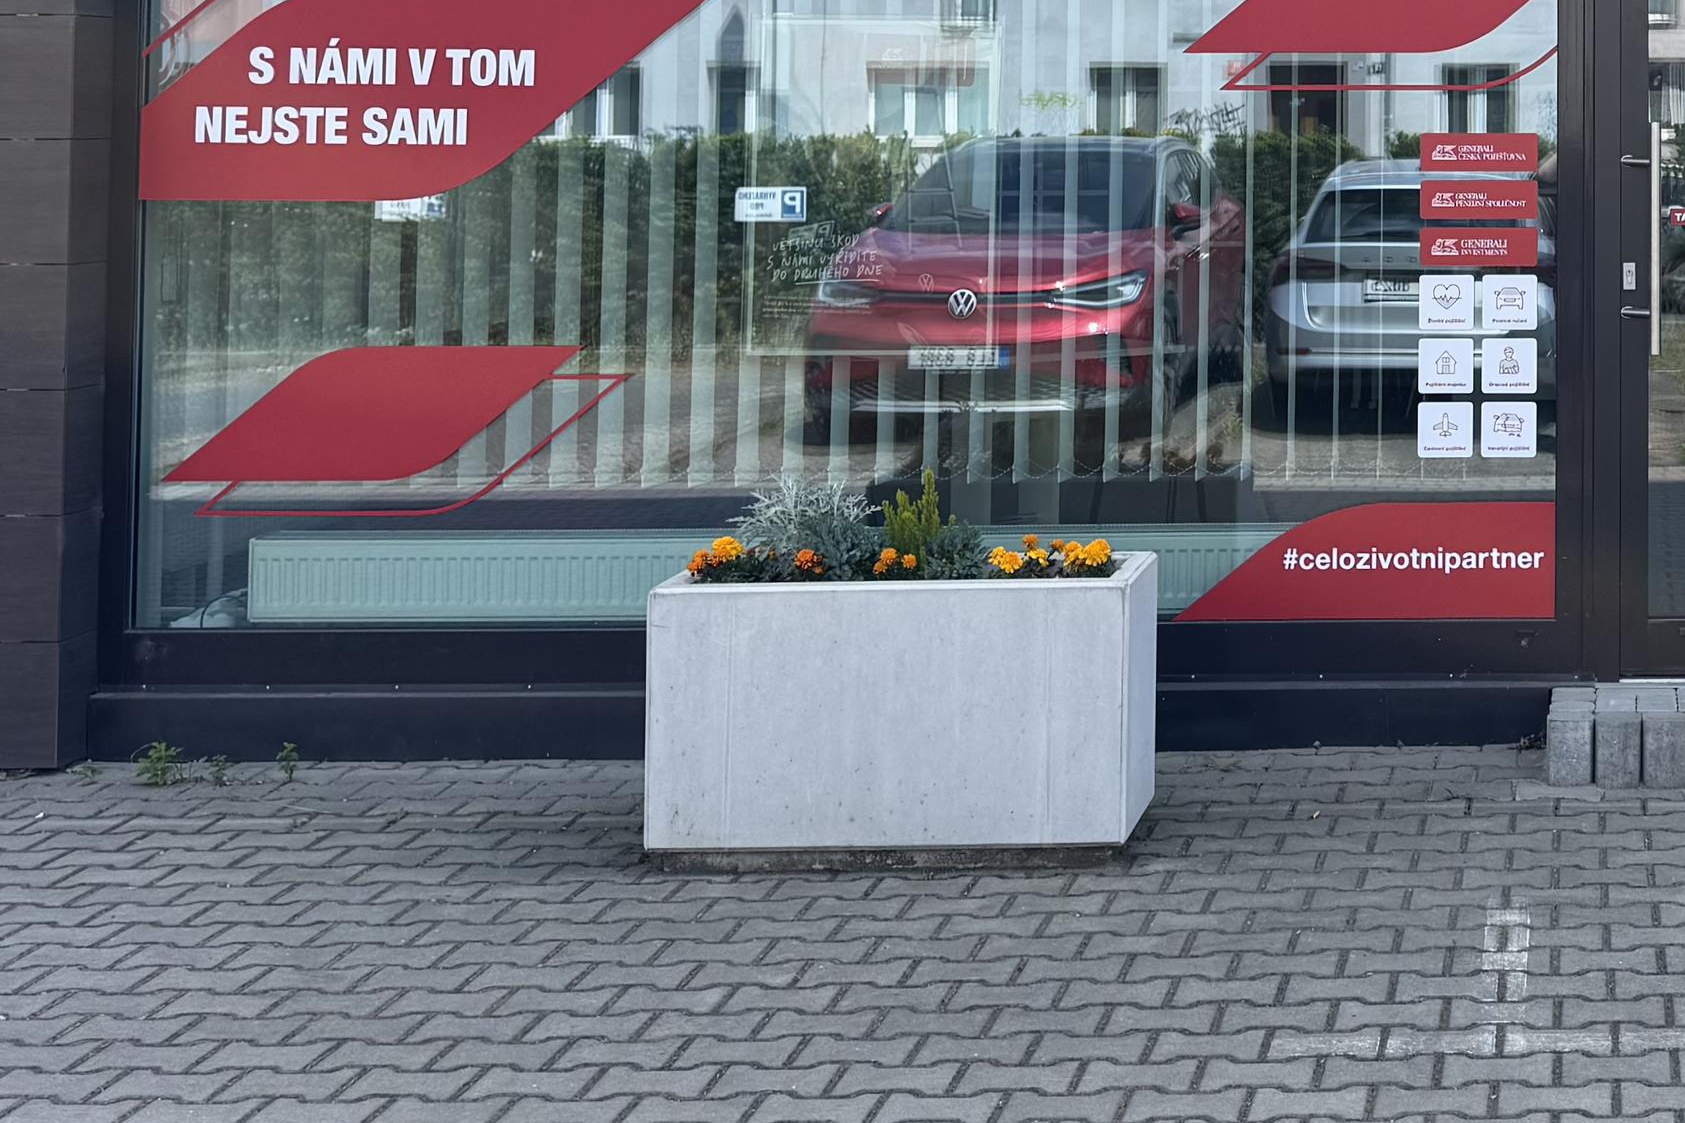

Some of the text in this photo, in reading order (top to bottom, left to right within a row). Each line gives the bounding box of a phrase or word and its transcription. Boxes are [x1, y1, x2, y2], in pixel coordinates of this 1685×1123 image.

[248, 37, 536, 87] S NÁMI V TOM
[195, 106, 468, 146] NEJSTE SAMI
[1461, 239, 1507, 248] GENERALI
[771, 267, 787, 282] DO
[856, 264, 883, 278] DNE
[1283, 547, 1545, 574] #celozivotnipartner
